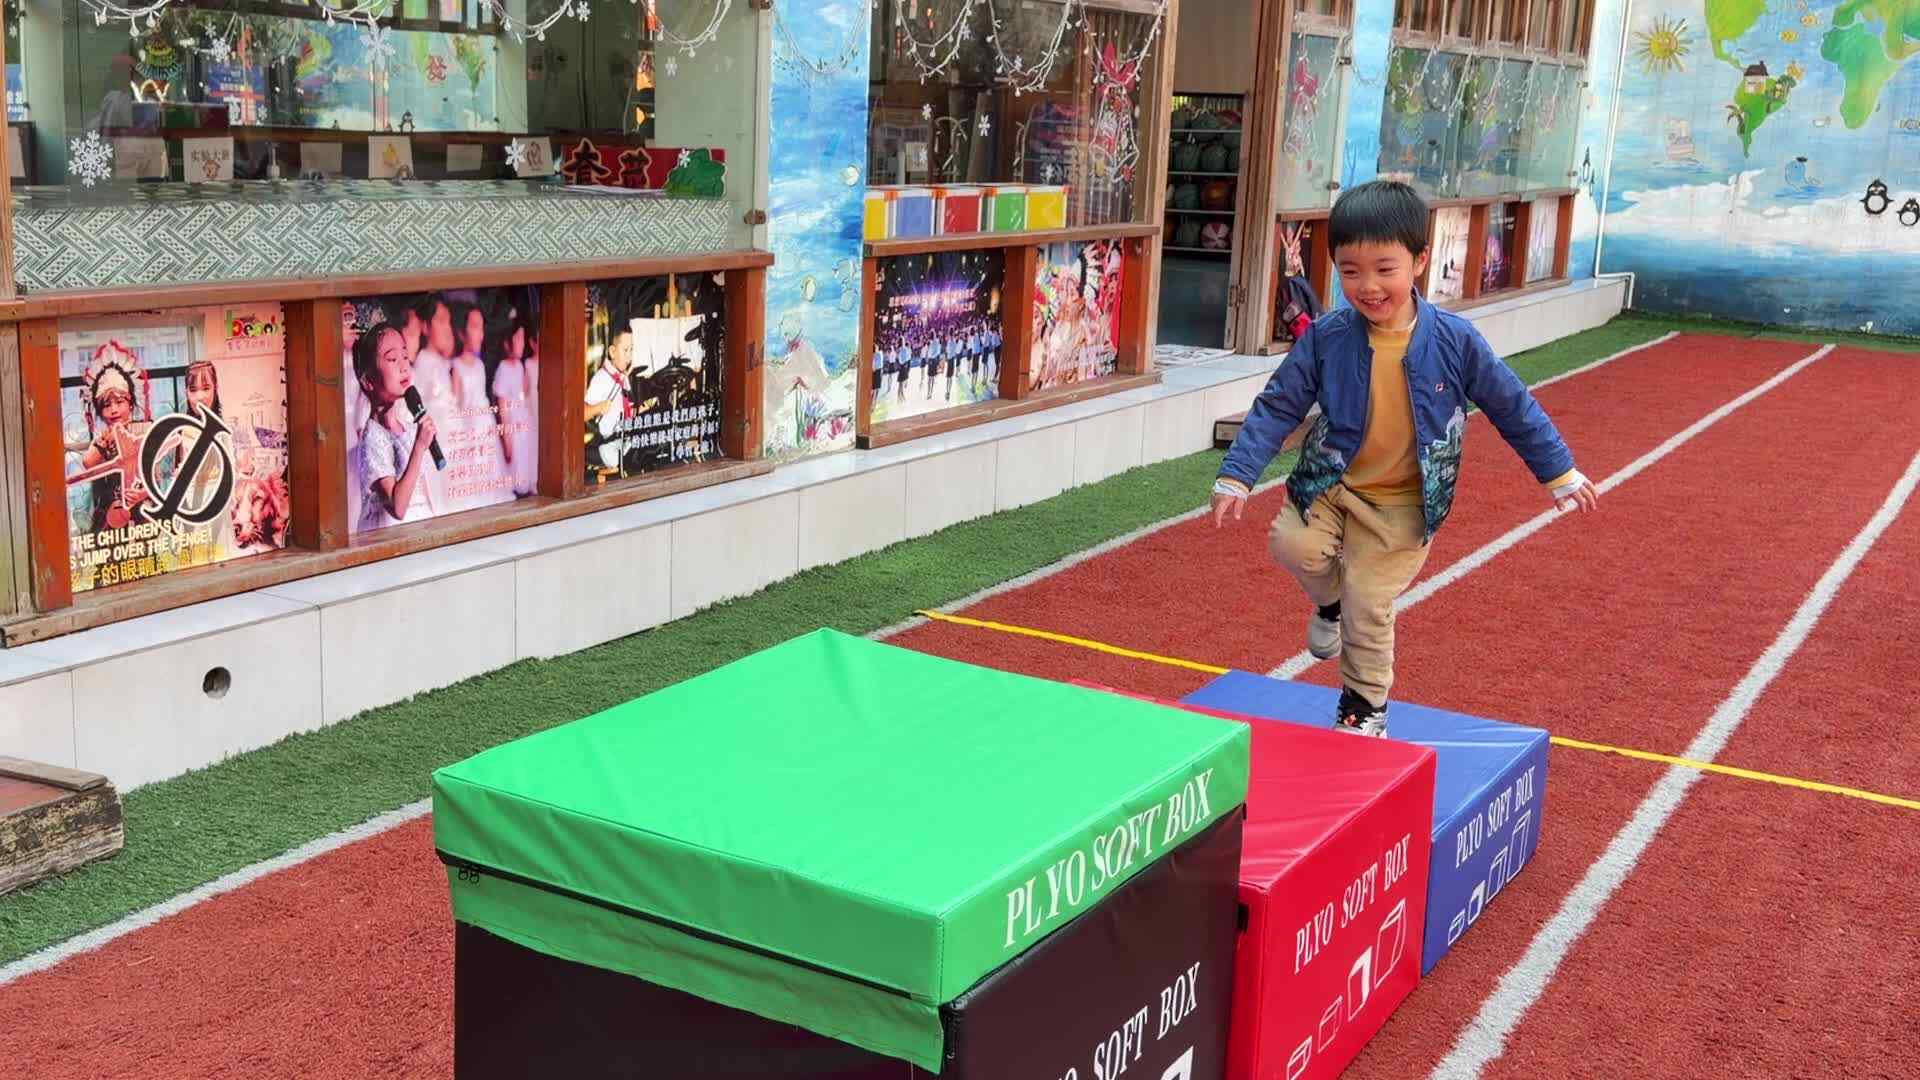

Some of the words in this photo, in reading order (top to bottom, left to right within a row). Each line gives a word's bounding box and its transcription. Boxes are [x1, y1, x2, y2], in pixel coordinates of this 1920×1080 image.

[71, 533, 95, 549] THE
[80, 550, 111, 567] JUMP
[113, 542, 145, 560] OVER
[147, 536, 170, 555] THE
[1004, 850, 1085, 948] PLYO
[1091, 803, 1162, 892] SOFT
[1161, 767, 1214, 846] BOX
[1456, 812, 1483, 869] PLYO
[1487, 786, 1512, 838] SOFT
[1514, 765, 1535, 812] BOX
[1294, 902, 1334, 975] PLYO
[1341, 862, 1378, 928] SOFT
[1384, 833, 1411, 891] BOX
[1093, 1005, 1148, 1080] SOFT
[1157, 961, 1200, 1040] BOX
